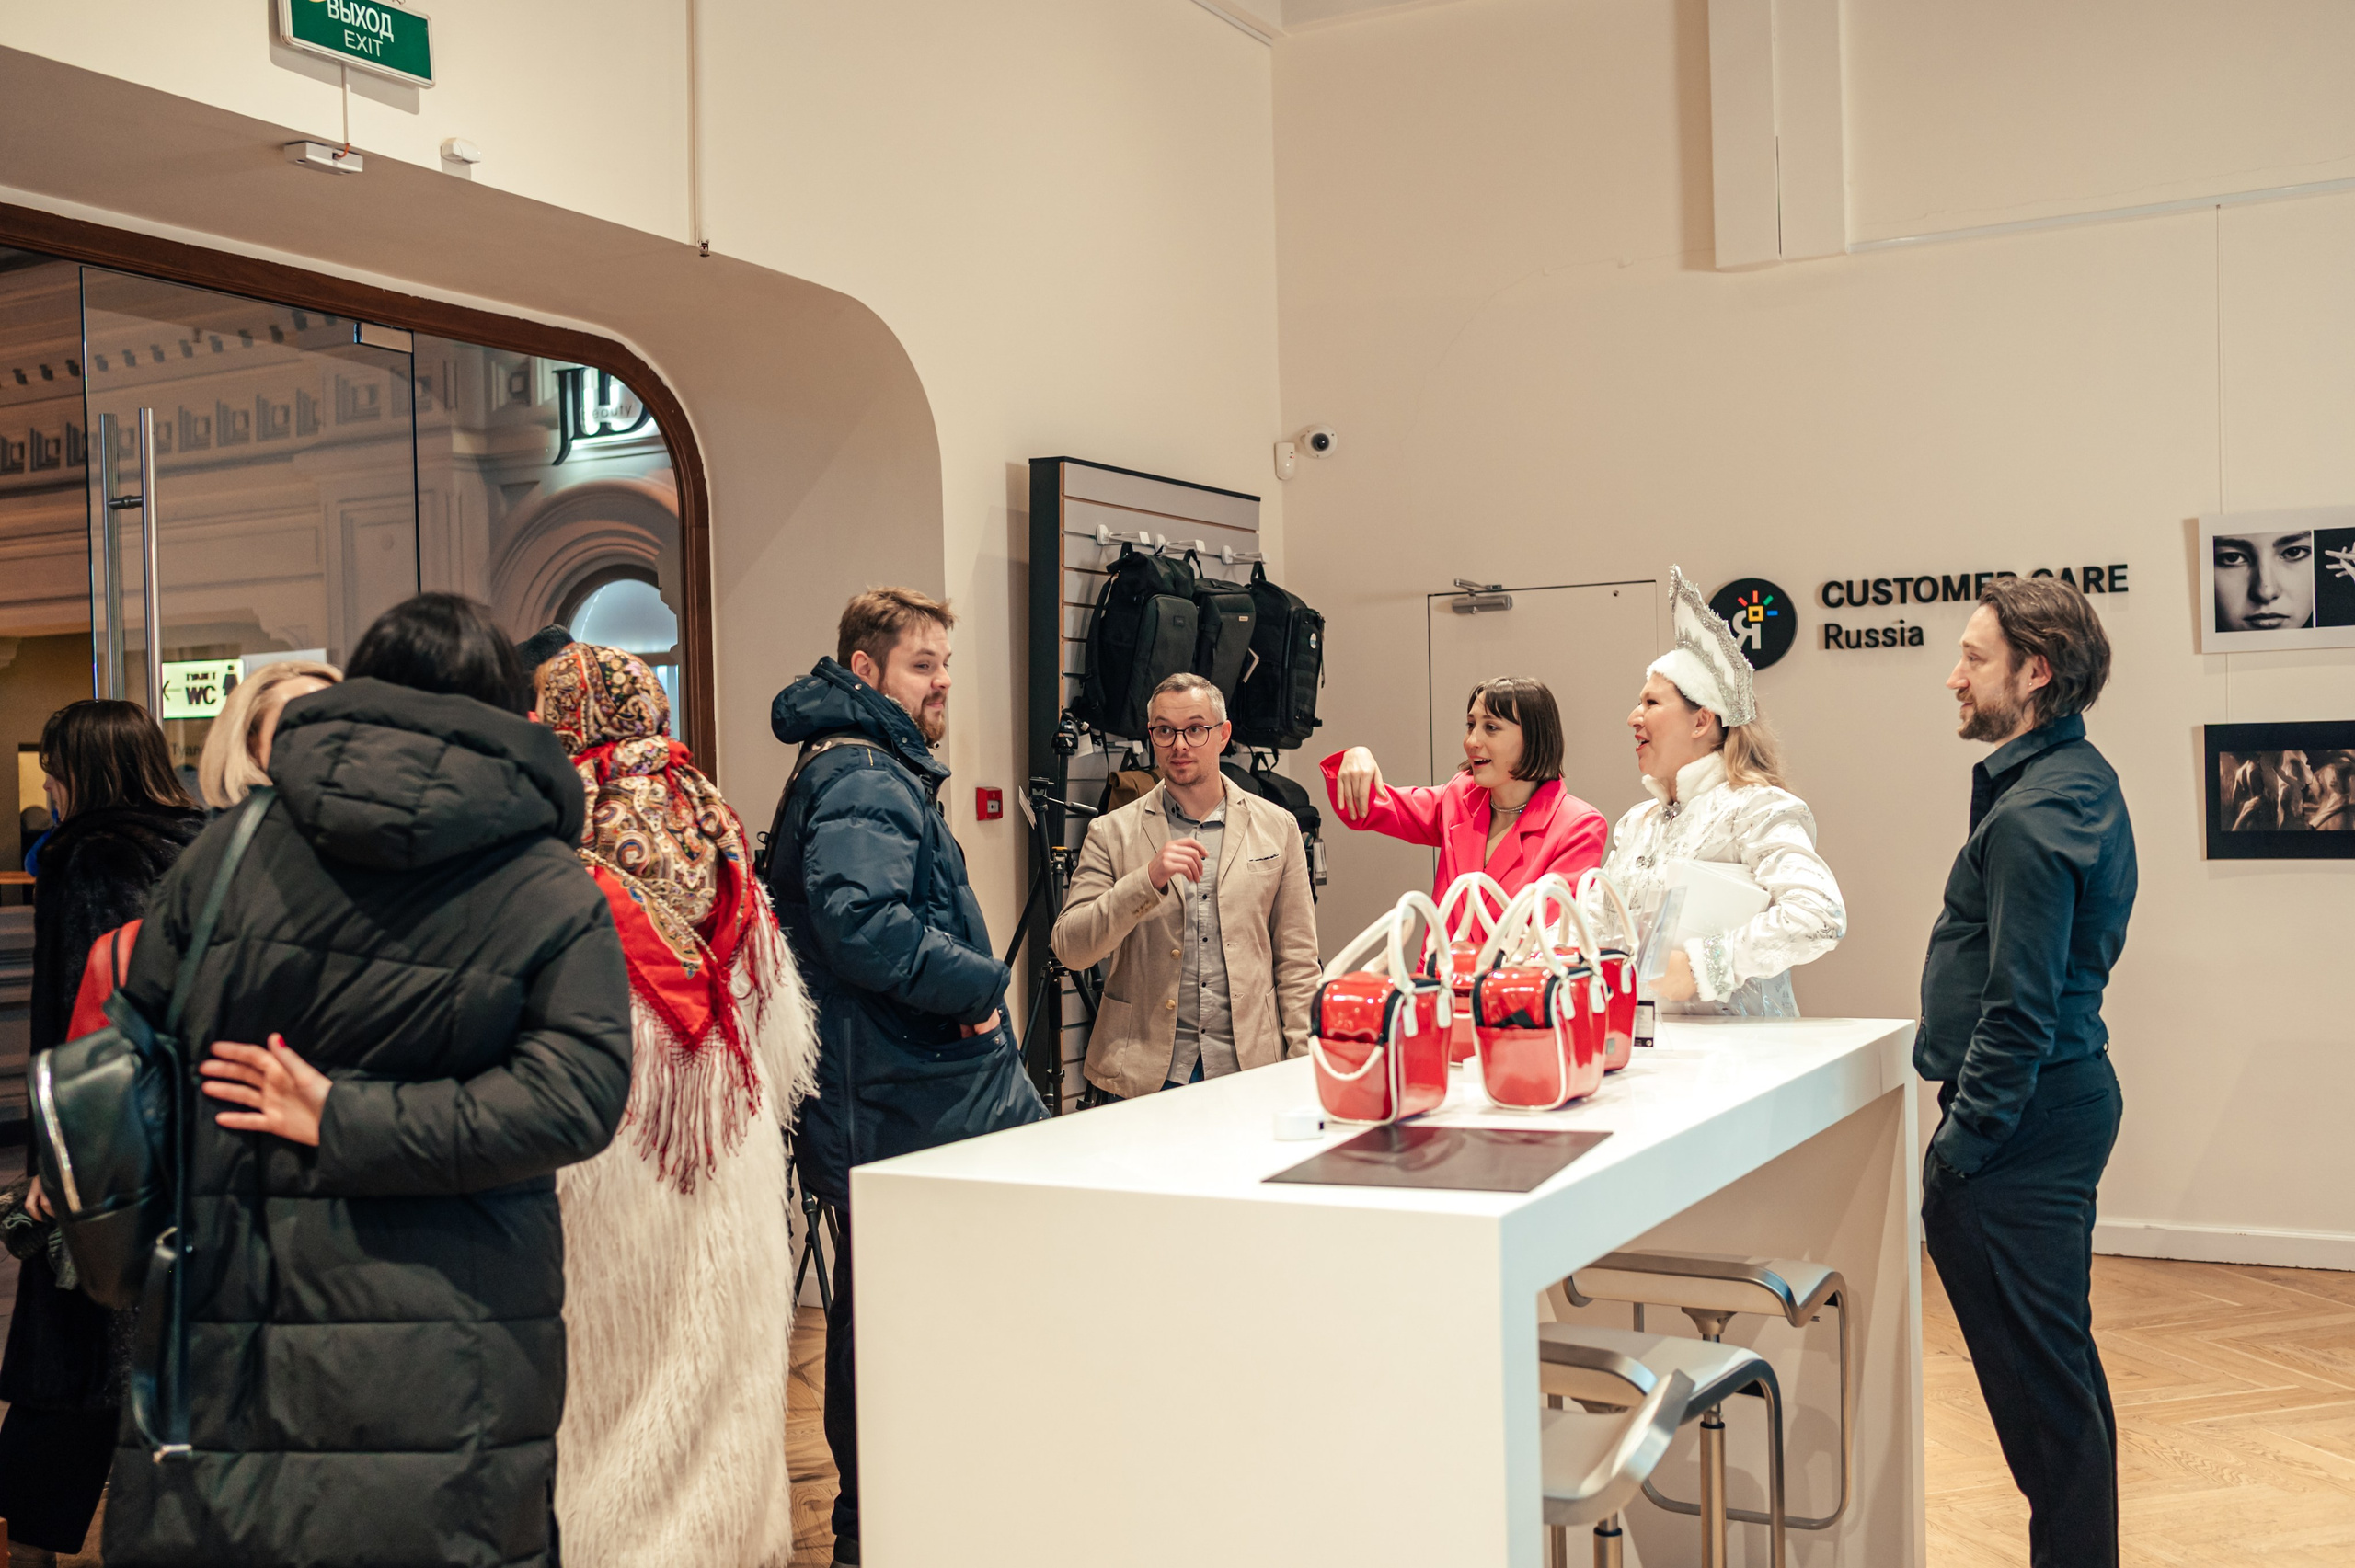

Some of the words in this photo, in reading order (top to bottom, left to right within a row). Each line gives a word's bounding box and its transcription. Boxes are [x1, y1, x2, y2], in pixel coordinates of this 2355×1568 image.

[327, 0, 395, 43] ВЫХОД
[344, 29, 383, 57] EXIT
[588, 404, 632, 420] eauty
[1824, 619, 1924, 649] Russia
[185, 685, 217, 705] WC
